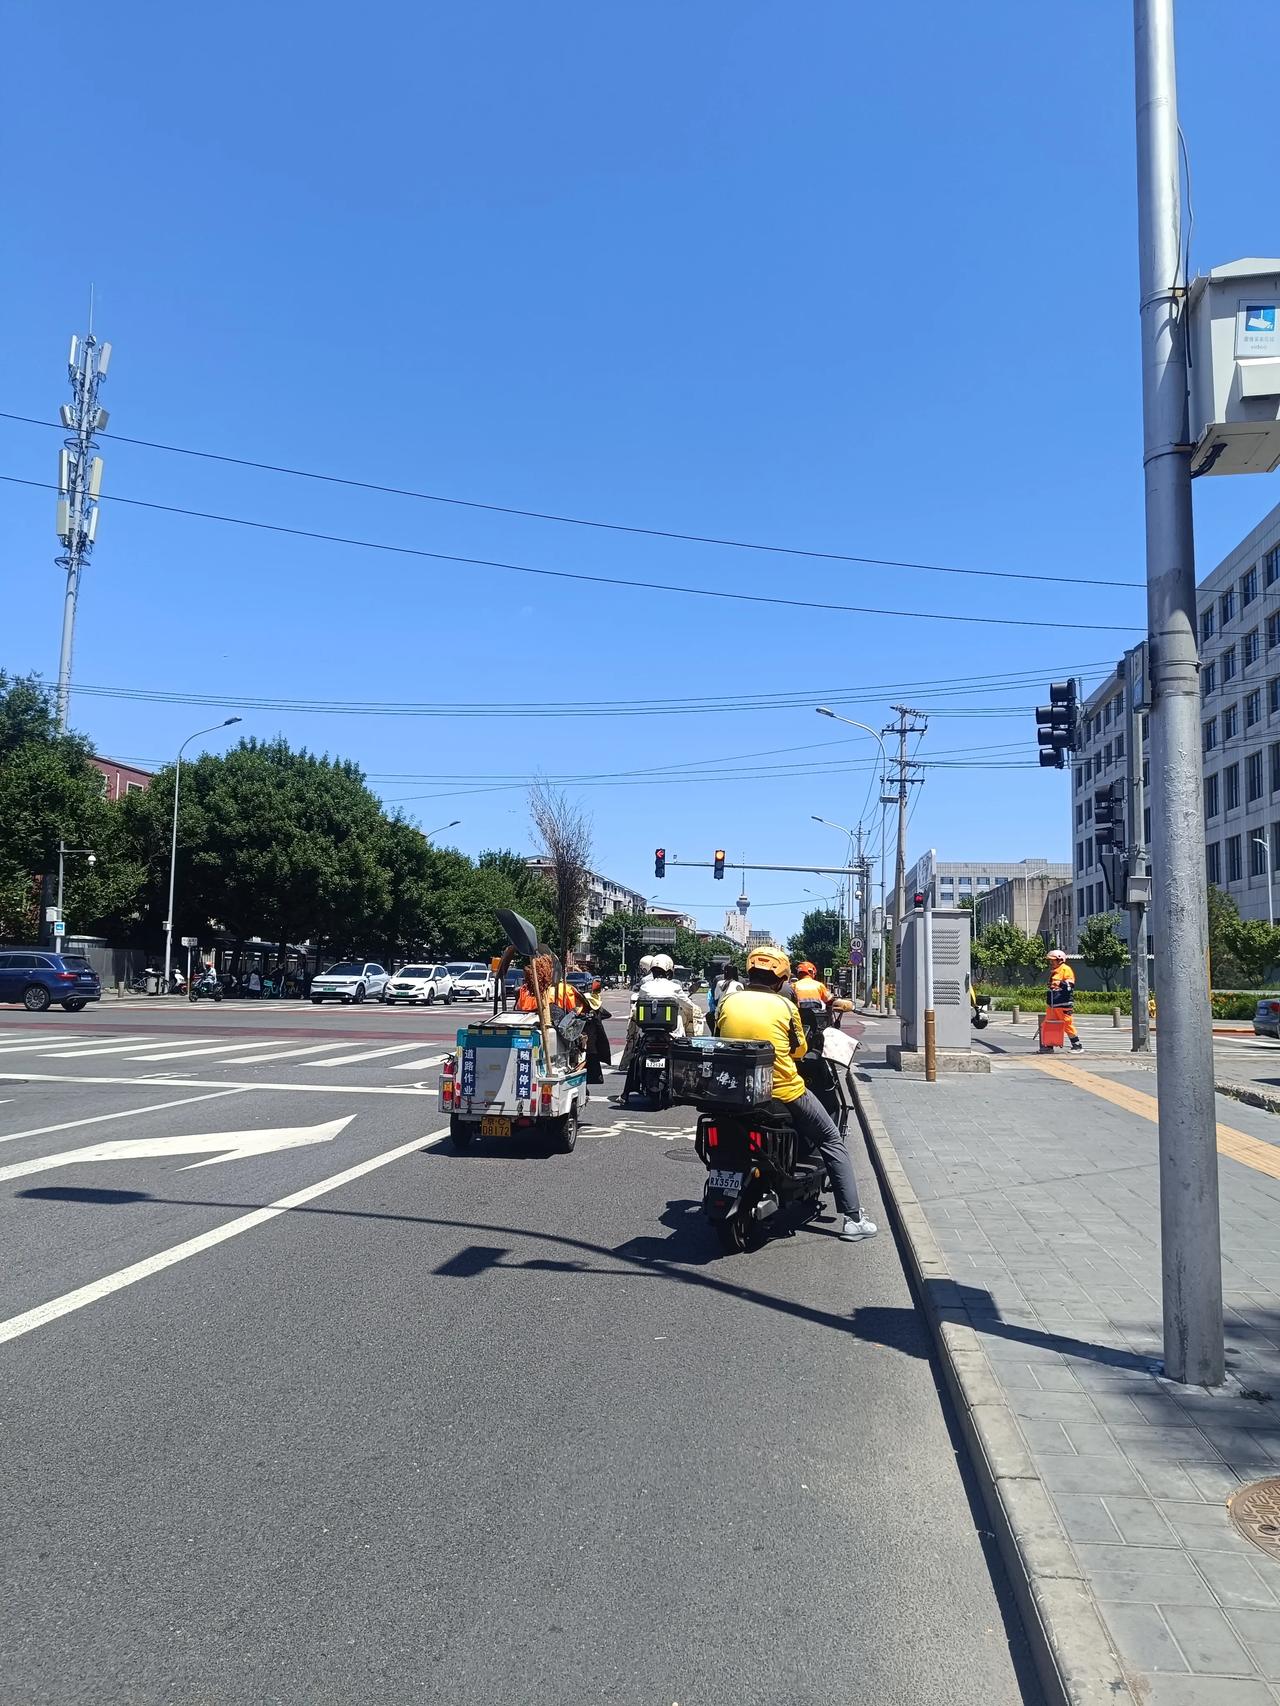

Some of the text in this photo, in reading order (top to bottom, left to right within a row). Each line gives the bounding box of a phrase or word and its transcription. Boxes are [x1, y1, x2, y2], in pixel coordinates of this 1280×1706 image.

[852, 940, 861, 948] 40
[463, 1048, 474, 1095] 道路作业
[519, 1050, 530, 1098] 随时停车
[710, 1176, 740, 1188] RX3570
